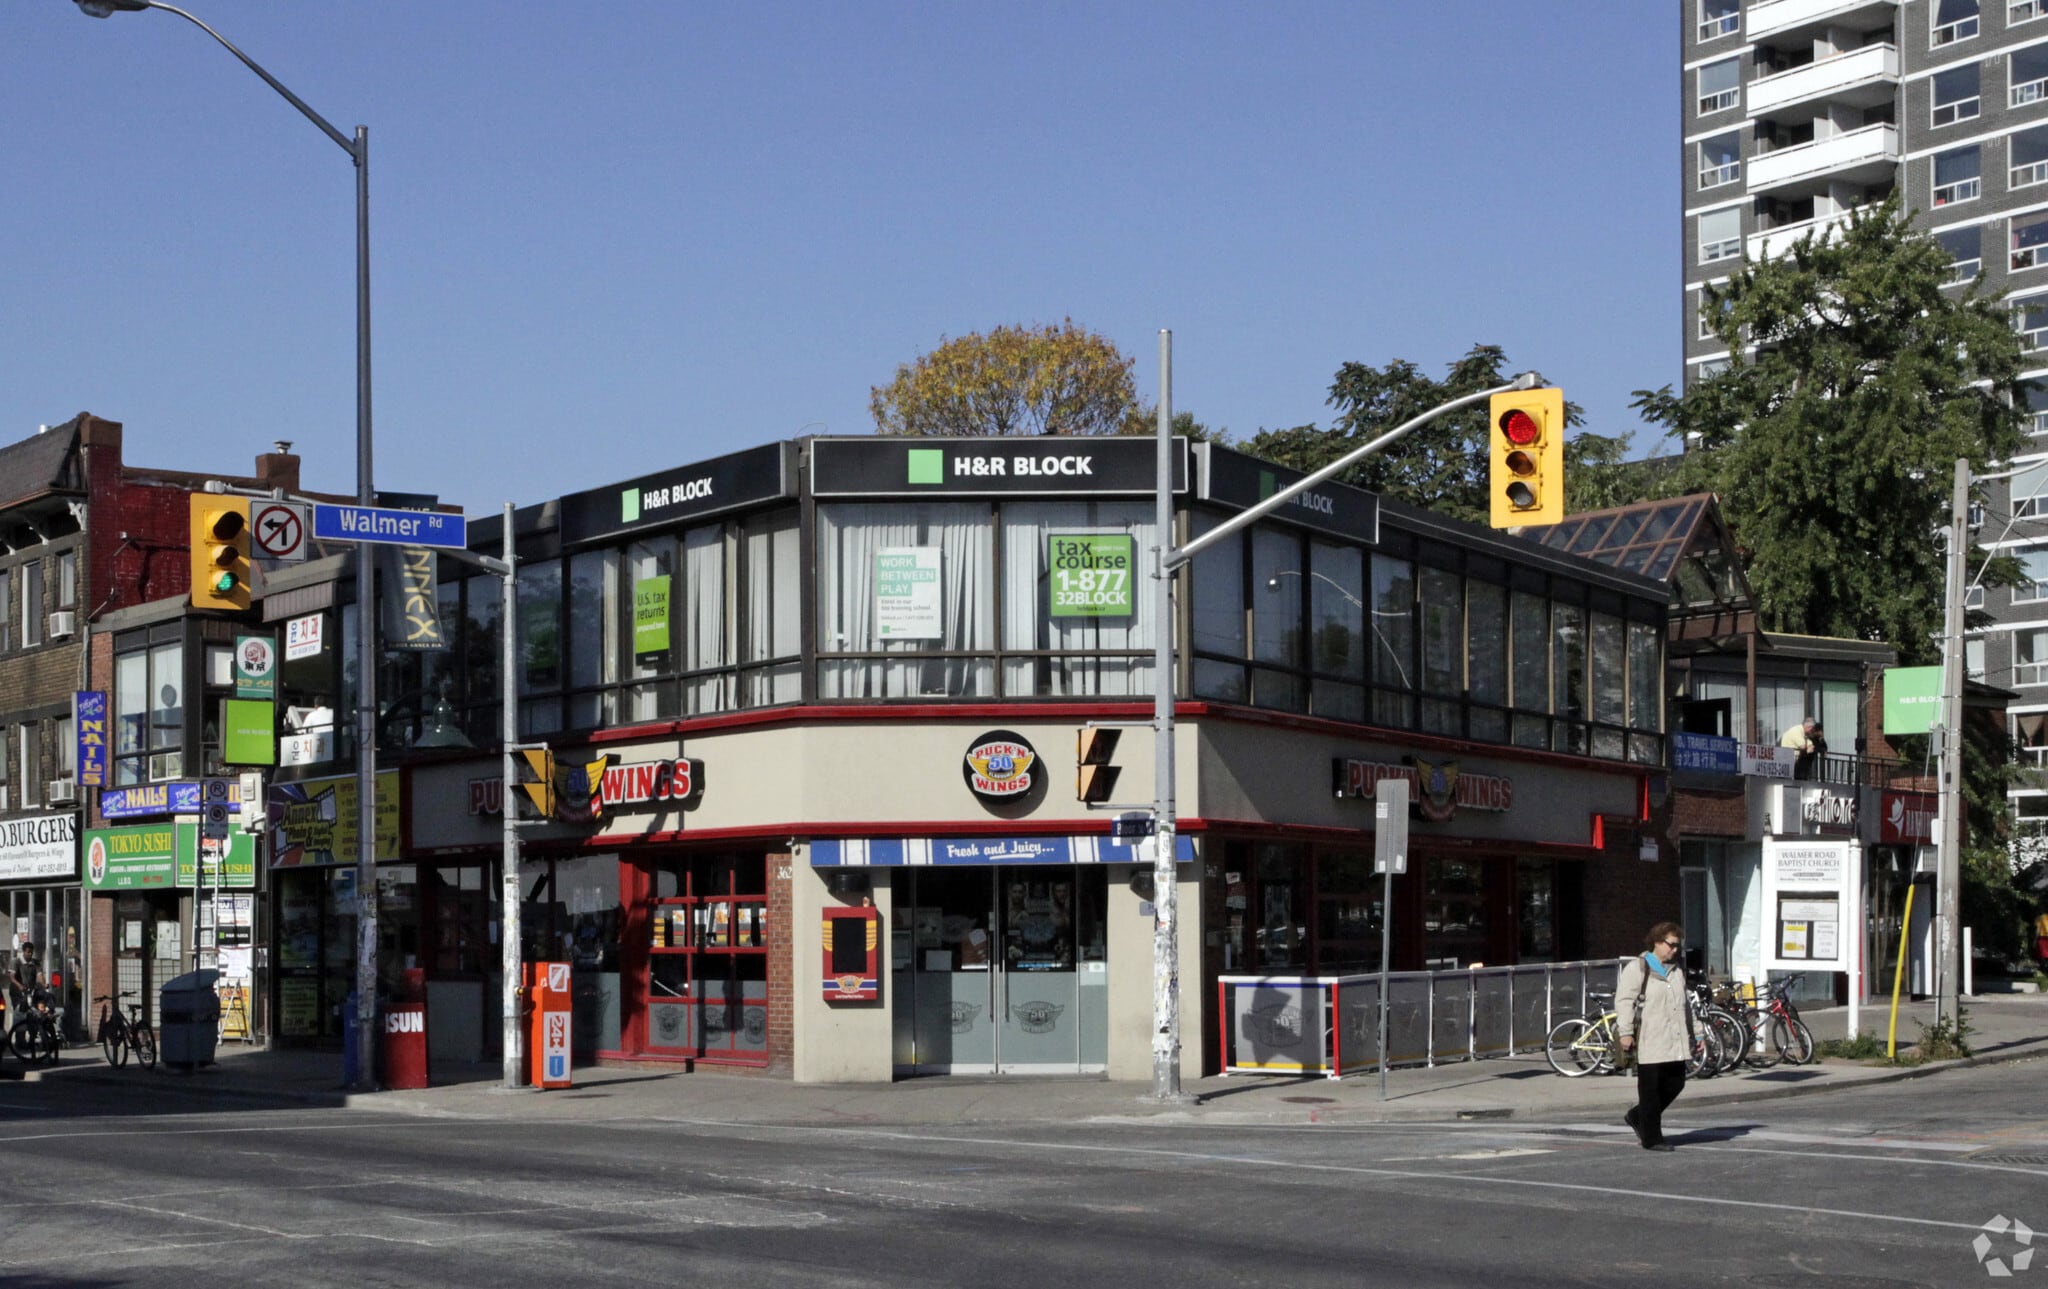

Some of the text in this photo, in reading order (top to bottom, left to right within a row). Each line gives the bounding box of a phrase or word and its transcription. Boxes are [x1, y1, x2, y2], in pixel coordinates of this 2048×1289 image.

[954, 455, 1093, 476] H&R BLOCK
[643, 476, 713, 511] H&R BLOCK
[1302, 490, 1334, 515] BLOCK
[339, 508, 443, 537] Walmer Rd
[1055, 540, 1092, 556] tax
[880, 557, 913, 568] WORK
[1055, 555, 1127, 569] course
[880, 570, 934, 581] BETWEEN
[1055, 569, 1127, 591] 1-877
[653, 592, 666, 603] tax
[1055, 591, 1127, 605] 32BLOCK
[636, 606, 665, 620] returns
[81, 720, 104, 784] NAILS
[976, 744, 1026, 760] PUCK'N
[988, 755, 1014, 770] 50
[602, 759, 690, 803] WINGS
[975, 775, 1028, 792] WINGS
[125, 785, 167, 809] NAILS
[1456, 773, 1512, 811] WINGS
[109, 832, 172, 854] TOKYO SUSHI
[946, 843, 979, 858] Fresh
[983, 841, 1007, 856] and
[1781, 850, 1836, 859] WALMER ROAD
[181, 864, 216, 873] TOYO
[1777, 860, 1839, 868] BAPTIST CHURCH
[388, 1011, 424, 1033] SUN
